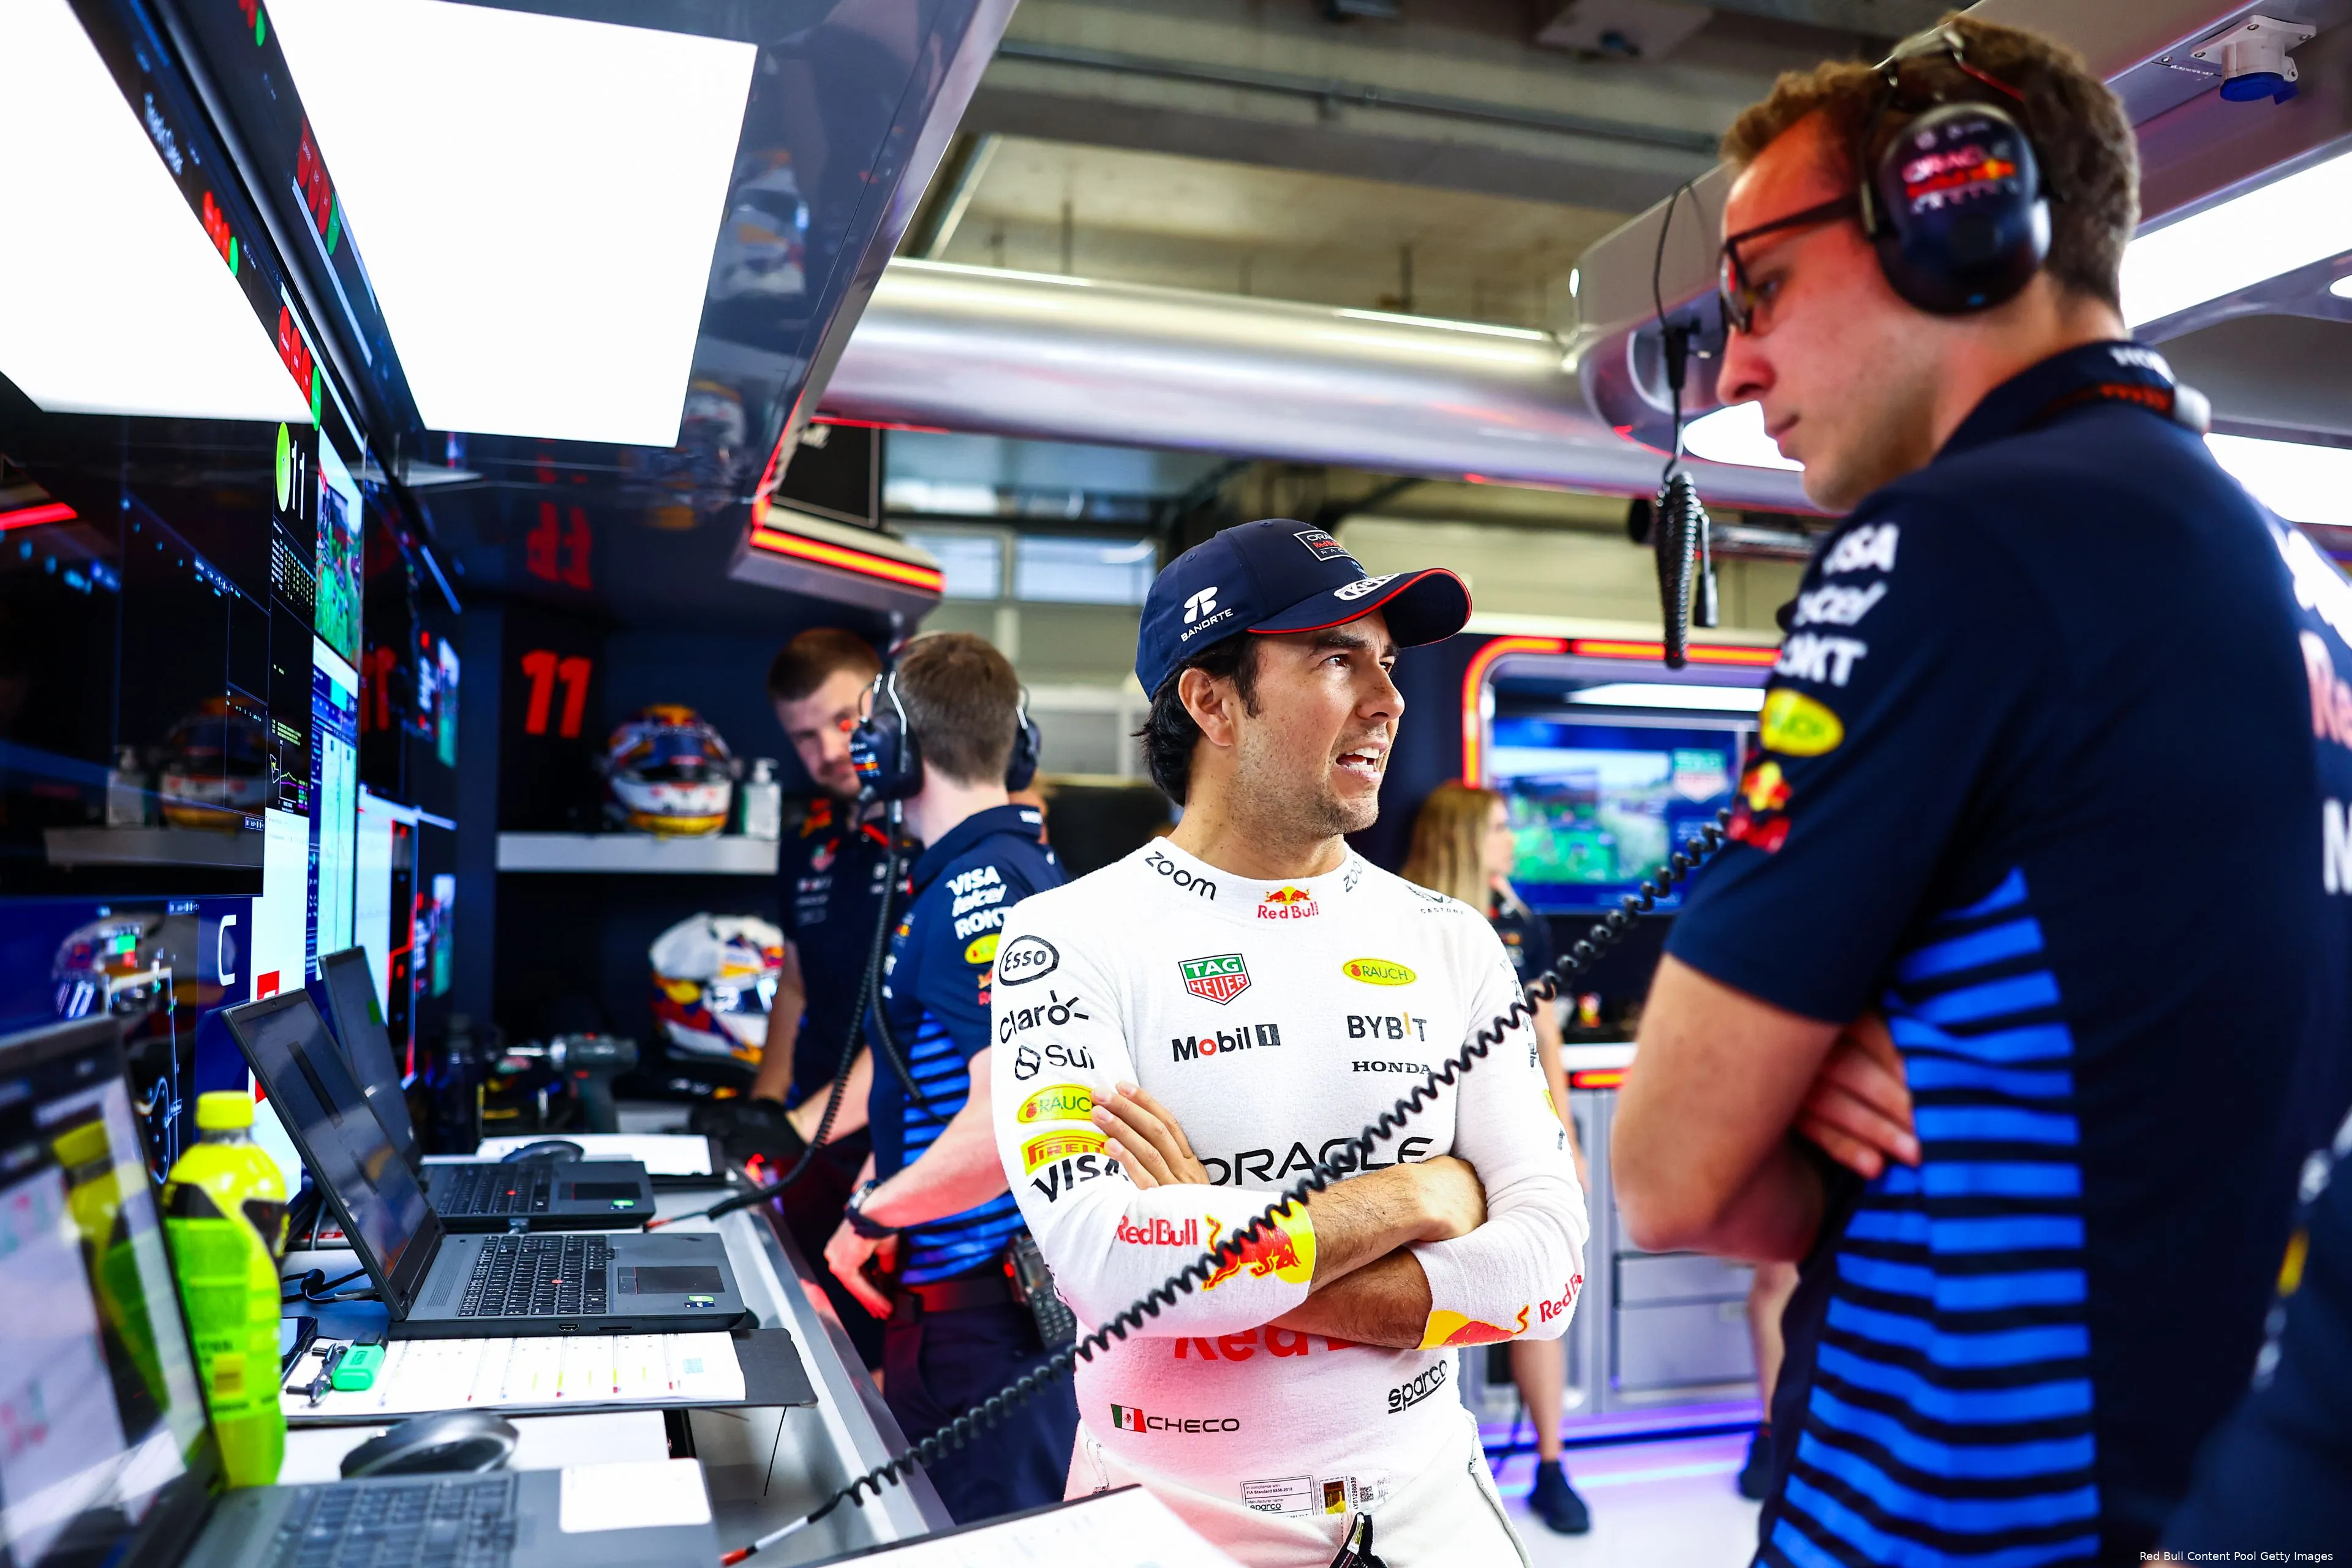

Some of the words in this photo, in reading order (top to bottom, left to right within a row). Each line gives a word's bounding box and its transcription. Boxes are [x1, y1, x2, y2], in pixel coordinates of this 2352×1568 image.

[291, 440, 306, 521] 11
[1180, 608, 1234, 642] BANORTE
[521, 648, 592, 739] 11
[945, 865, 1002, 896] VISA
[1145, 851, 1216, 900] zoom
[1343, 860, 1362, 892] zoo
[1257, 905, 1289, 919] Red
[1292, 901, 1319, 919] Bull
[1186, 958, 1240, 978] TAG
[1362, 965, 1409, 981] RAUCH
[1190, 974, 1246, 1000] HEUER
[1346, 1012, 1428, 1042] BYBIT
[1045, 1044, 1095, 1069] Sui
[1172, 1027, 1252, 1062] Mobil
[1352, 1061, 1433, 1075] HONDA
[1040, 1096, 1091, 1114] RAUC
[1115, 1215, 1153, 1246] Red
[1155, 1218, 1198, 1246] Bull
[1539, 1283, 1572, 1323] Red
[1387, 1359, 1448, 1412] sparco
[1147, 1416, 1240, 1433] CHECO
